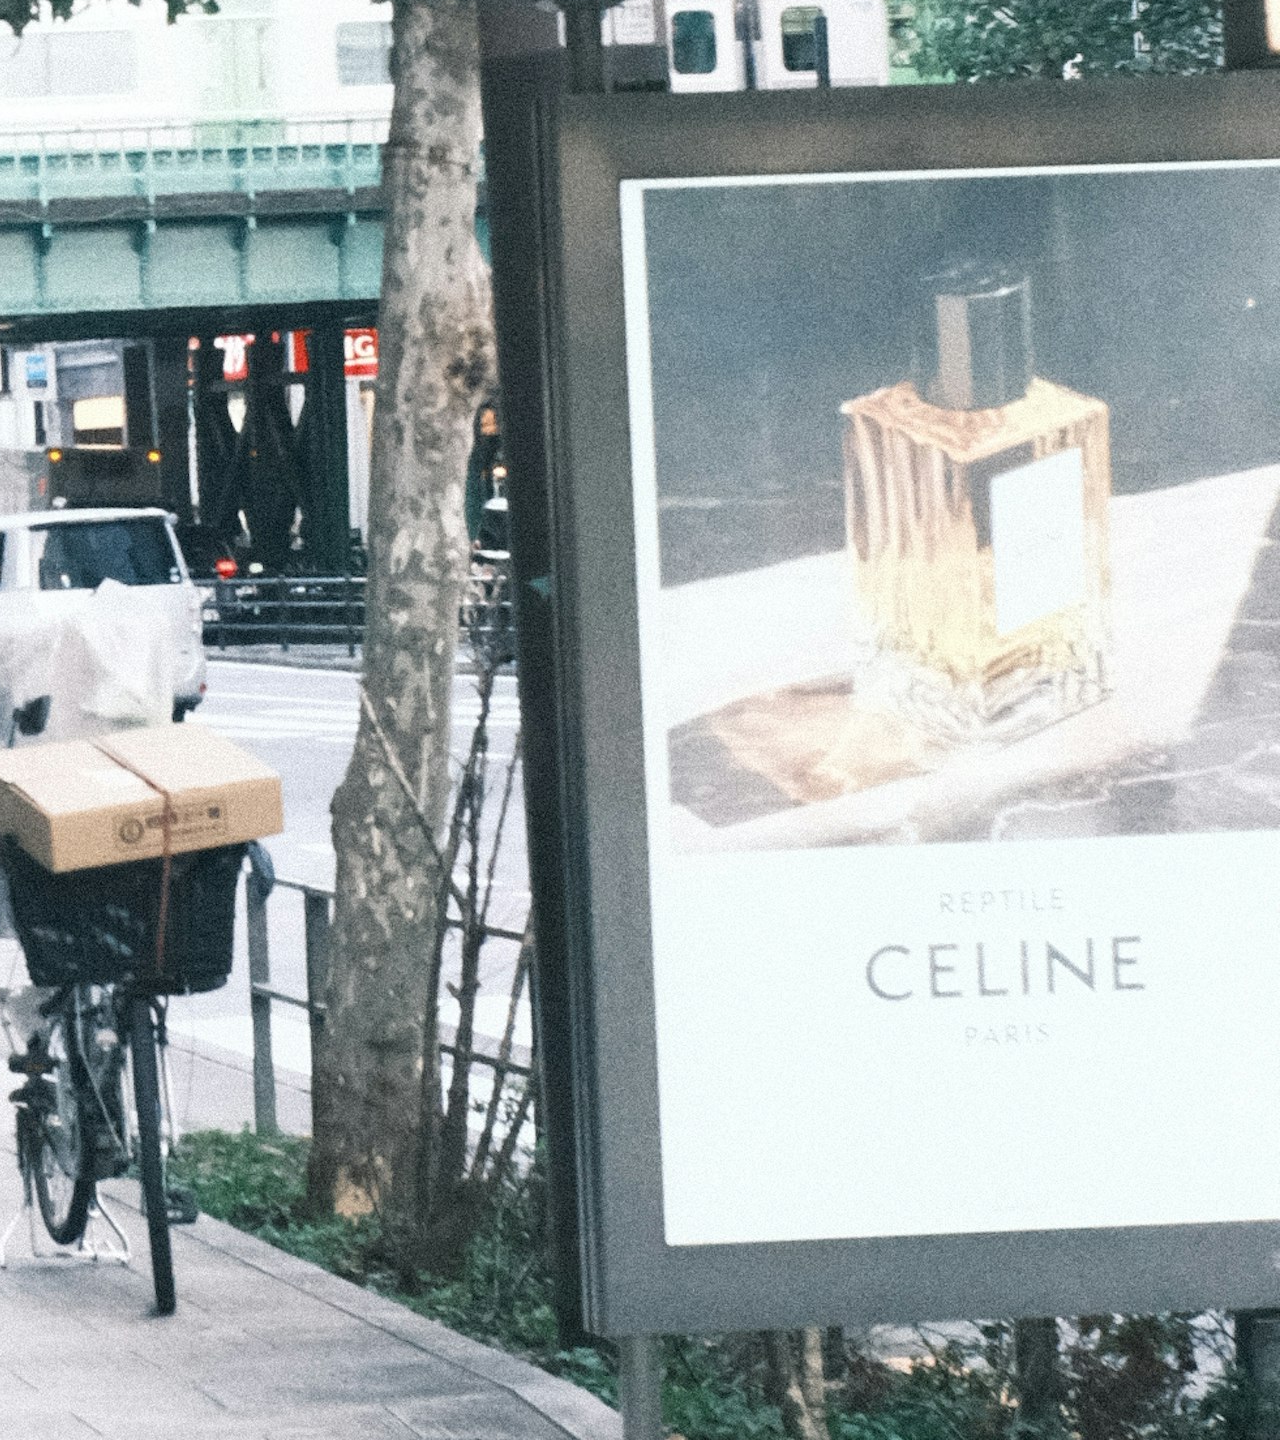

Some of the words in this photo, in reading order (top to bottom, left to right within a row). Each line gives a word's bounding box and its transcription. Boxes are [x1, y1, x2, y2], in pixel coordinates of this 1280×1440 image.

[938, 887, 1066, 915] REPTILE
[864, 934, 1147, 1003] CELINE
[964, 1022, 1051, 1047] PARIS
